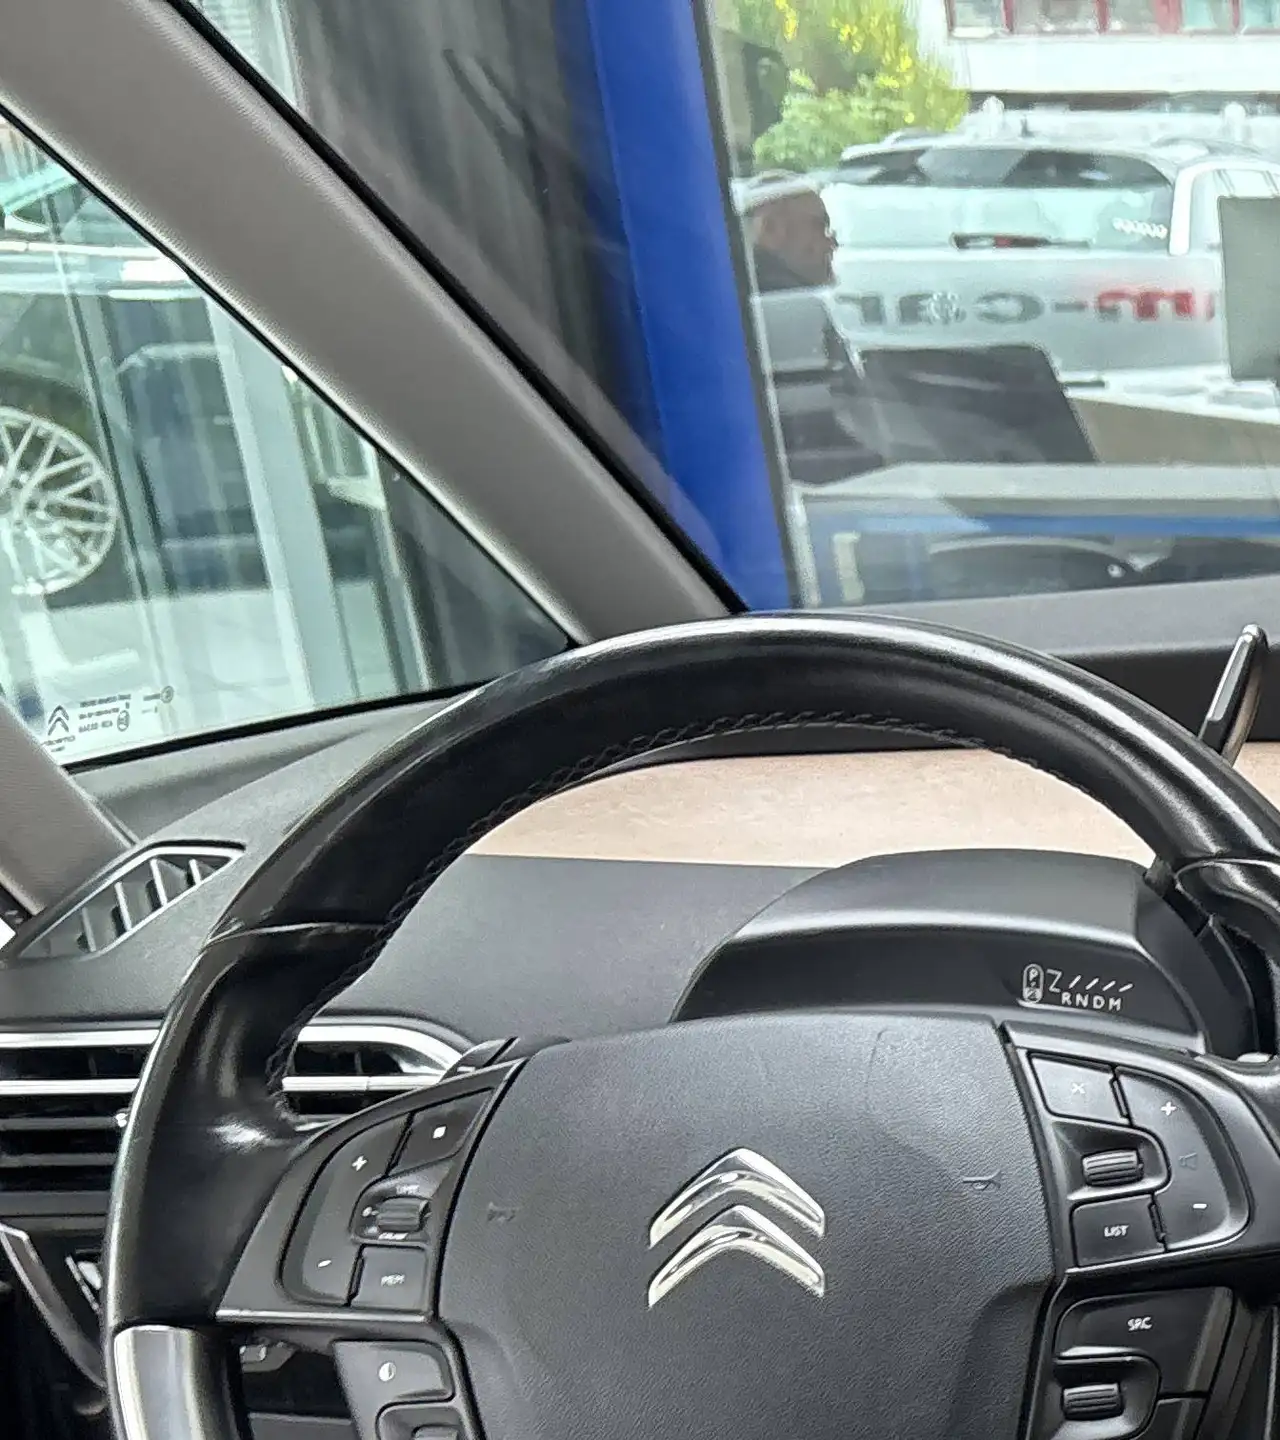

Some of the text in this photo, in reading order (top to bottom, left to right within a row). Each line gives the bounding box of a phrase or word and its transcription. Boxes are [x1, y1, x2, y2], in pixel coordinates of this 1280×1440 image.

[1061, 991, 1122, 1011] R N D M
